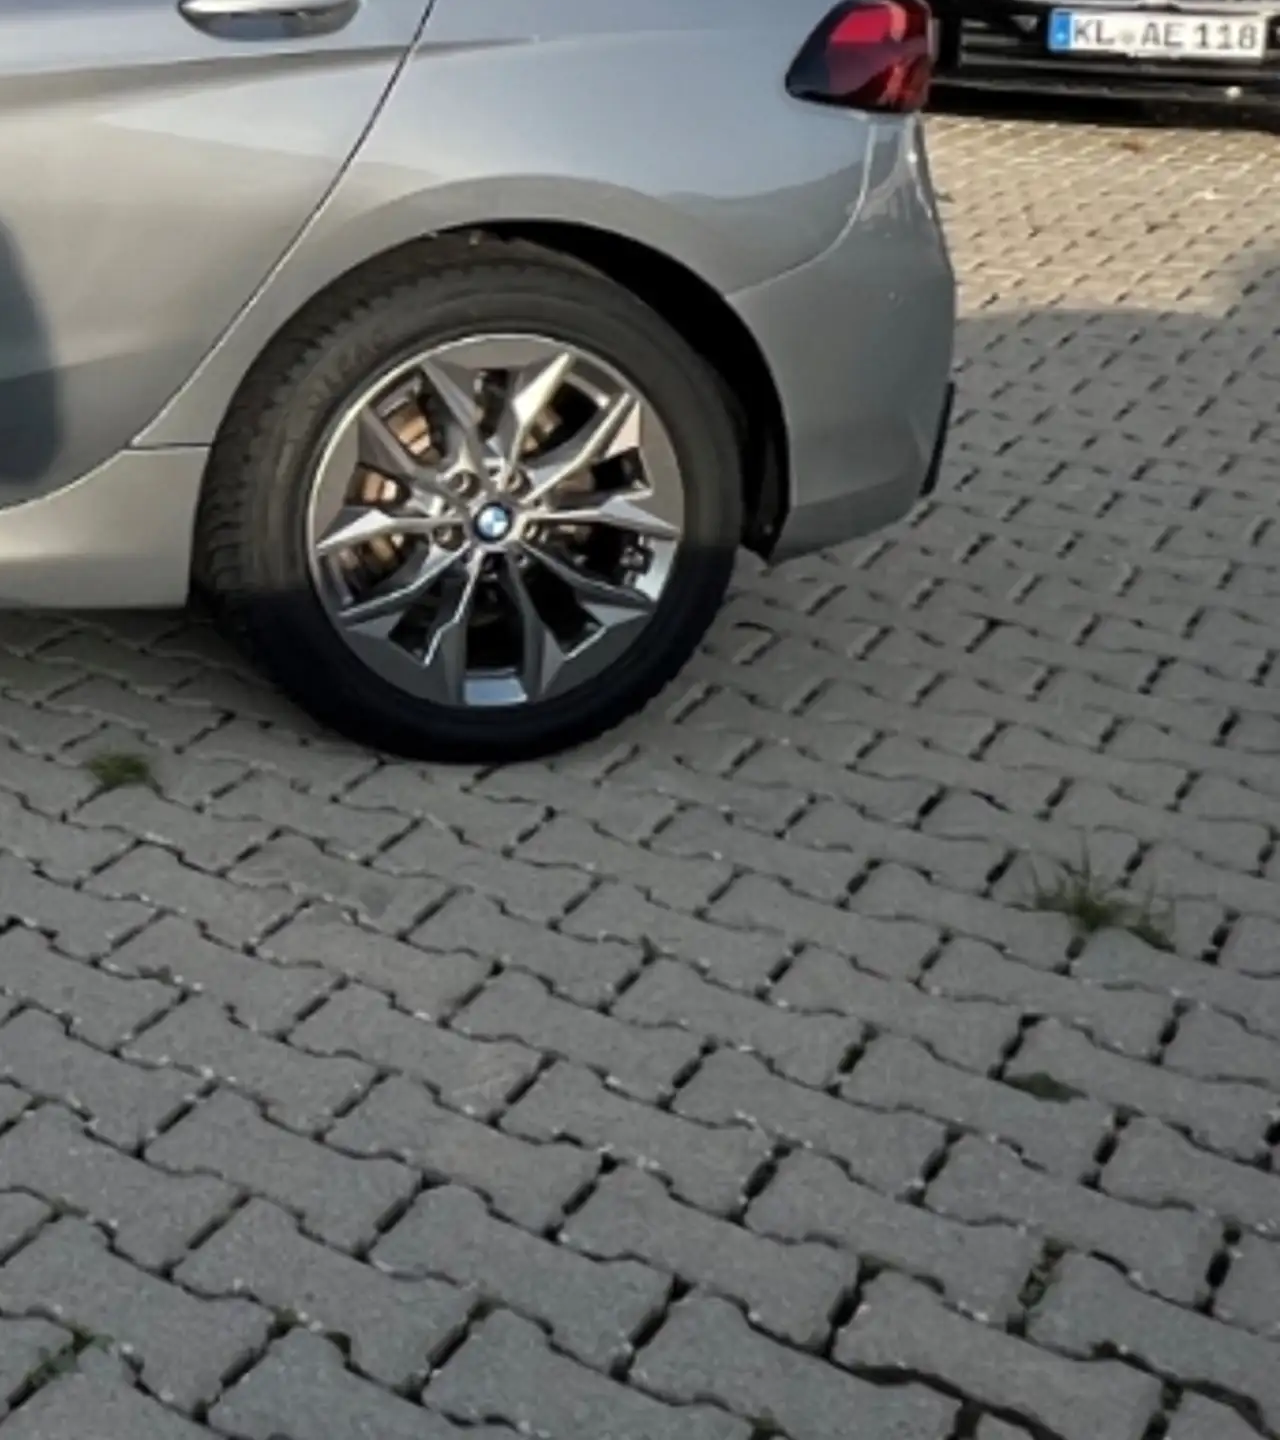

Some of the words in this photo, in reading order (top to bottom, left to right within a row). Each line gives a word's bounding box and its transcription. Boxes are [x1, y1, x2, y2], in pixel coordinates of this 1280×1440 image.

[1073, 19, 1115, 46] KL
[1141, 22, 1184, 48] AE
[1194, 22, 1258, 50] 118
